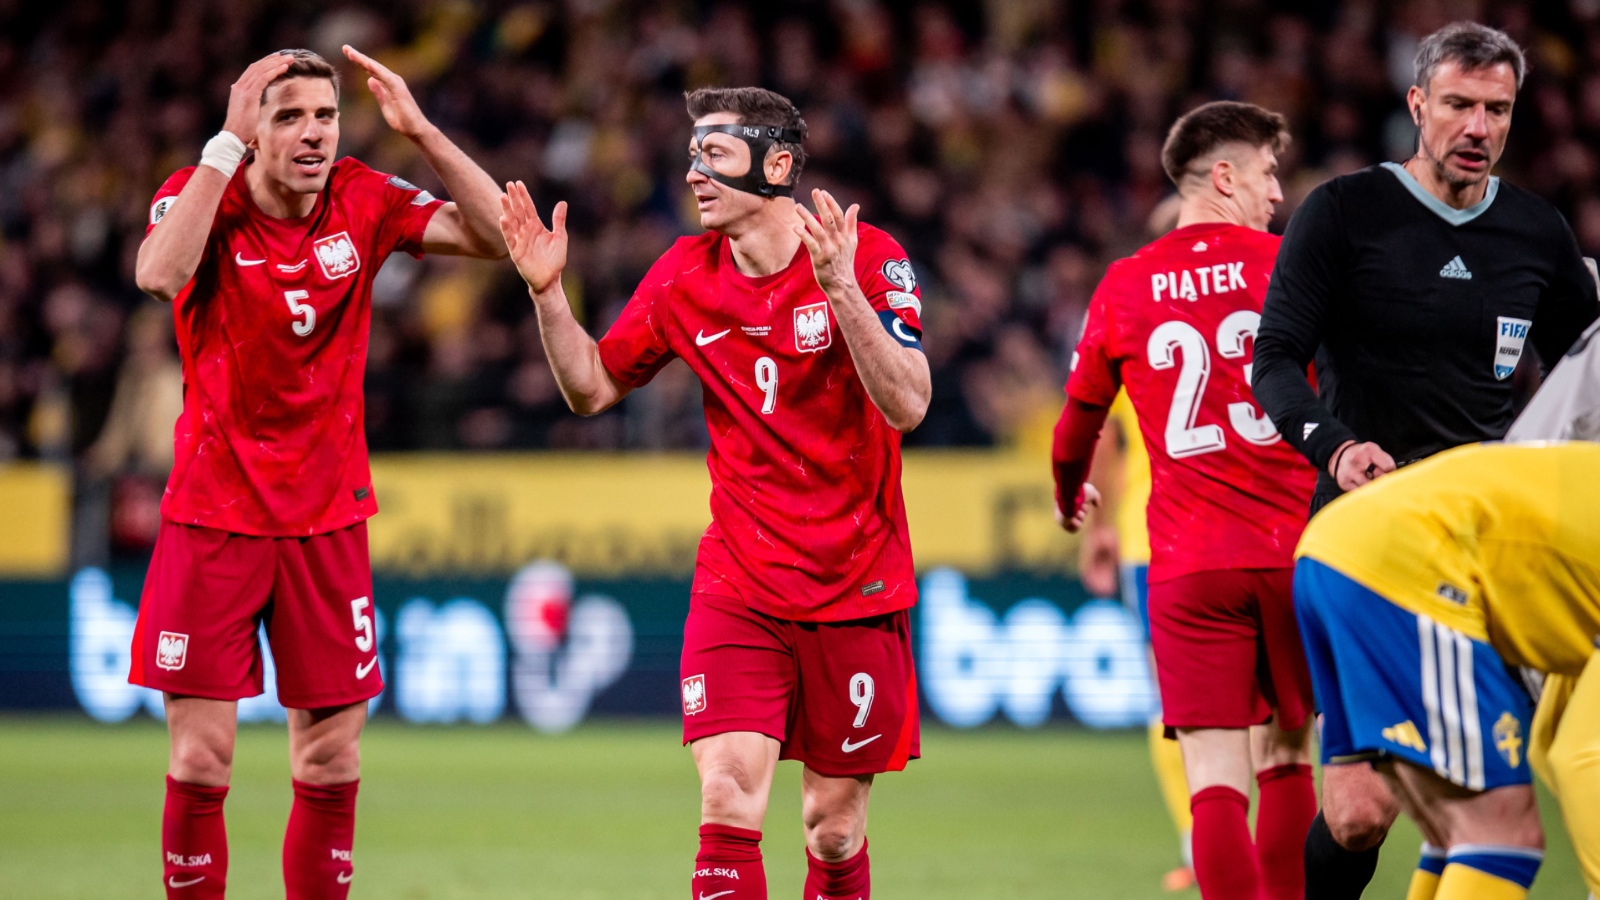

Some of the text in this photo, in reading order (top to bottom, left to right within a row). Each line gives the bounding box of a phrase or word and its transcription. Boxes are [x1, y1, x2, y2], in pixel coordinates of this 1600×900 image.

[743, 126, 760, 138] RL9
[1151, 262, 1247, 302] PIĄTEK
[1439, 269, 1472, 279] adidas
[284, 289, 316, 337] 5
[892, 317, 917, 342] C
[1501, 322, 1527, 339] FIFA
[1499, 346, 1521, 356] REFEREE
[755, 356, 778, 415] 9
[1147, 310, 1282, 460] 23
[351, 596, 373, 652] 5
[849, 672, 875, 728] 9
[167, 851, 212, 867] POLSKA
[331, 848, 352, 861] POL
[692, 867, 740, 880] POLSKA
